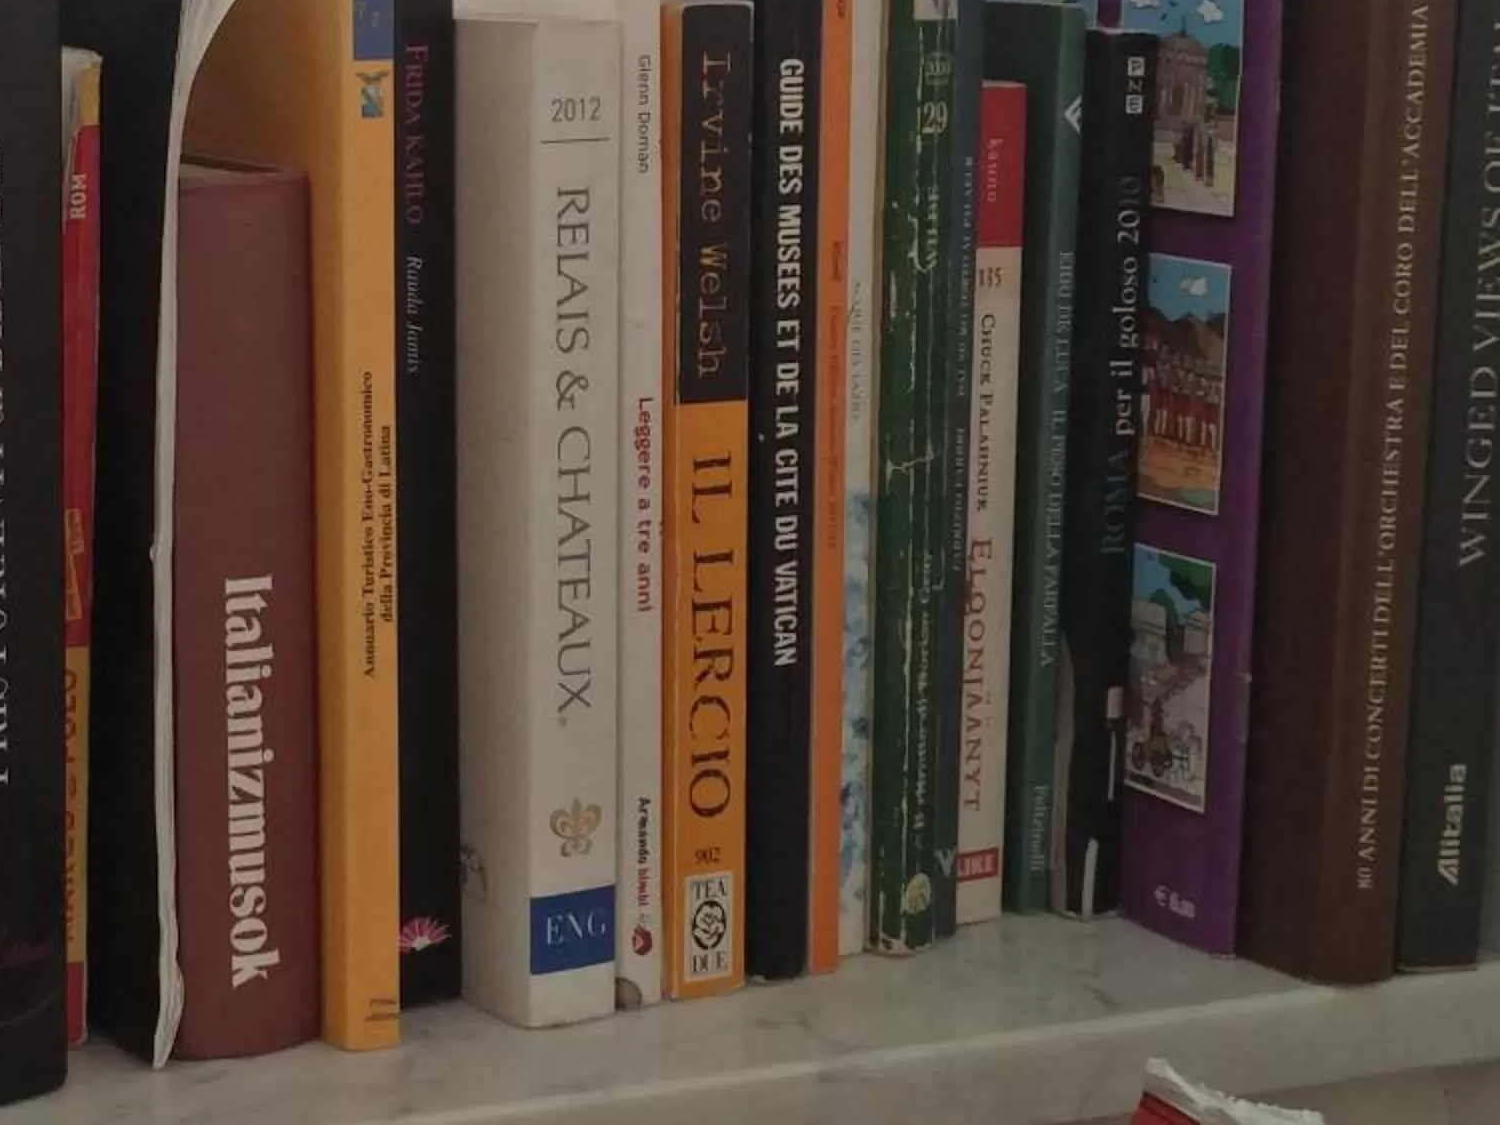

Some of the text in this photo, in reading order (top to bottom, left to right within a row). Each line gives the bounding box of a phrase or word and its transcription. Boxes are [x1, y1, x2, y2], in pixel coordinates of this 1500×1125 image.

[404, 44, 429, 125] FRIDA
[551, 95, 601, 123] 2012
[921, 101, 949, 135] 29
[698, 51, 732, 379] Irvine Welsh
[555, 186, 591, 355] RELAIS
[1111, 256, 1140, 349] goloso
[1393, 242, 1413, 315] CORO
[773, 58, 805, 667] GUIDE DES MUSEES ET DE LA CITE DU VATICAN
[1109, 359, 1134, 377] il
[1389, 321, 1409, 370] DEL
[555, 370, 590, 412] &
[1115, 391, 1136, 437] per
[634, 396, 654, 613] Leggere a tre anni
[1458, 365, 1500, 567] WINGED
[688, 450, 736, 818] IL LERCIO
[1363, 630, 1389, 760] CONCERTI
[224, 575, 280, 988] Italianizmusok
[1361, 765, 1381, 792] DI
[1357, 797, 1379, 862] ANNI
[1437, 763, 1467, 886] Alitalia
[691, 878, 729, 900] TEA
[545, 911, 606, 946] ENG
